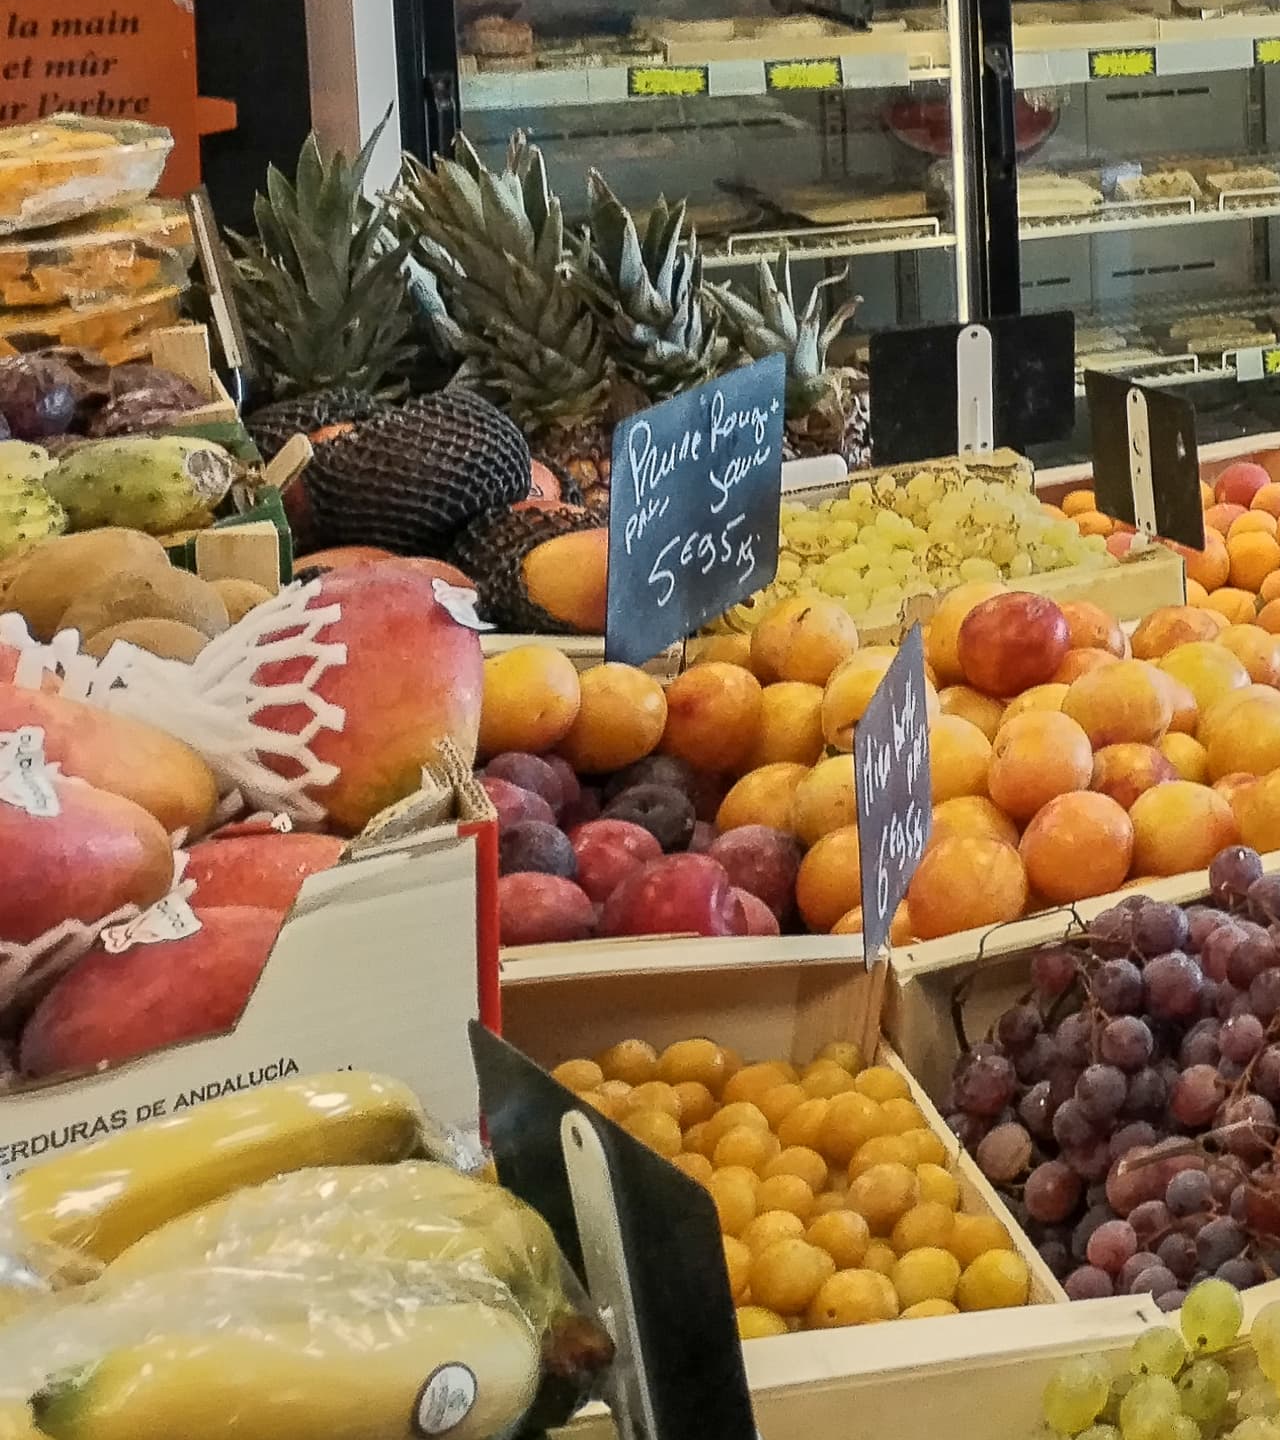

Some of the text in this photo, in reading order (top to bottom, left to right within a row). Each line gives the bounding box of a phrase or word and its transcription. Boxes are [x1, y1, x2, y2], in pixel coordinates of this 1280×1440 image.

[7, 11, 141, 40] la main
[2, 49, 119, 81] et mûr
[0, 97, 27, 122] ur
[0, 1057, 299, 1166] ERDURAS DE ANDALUCÍA
